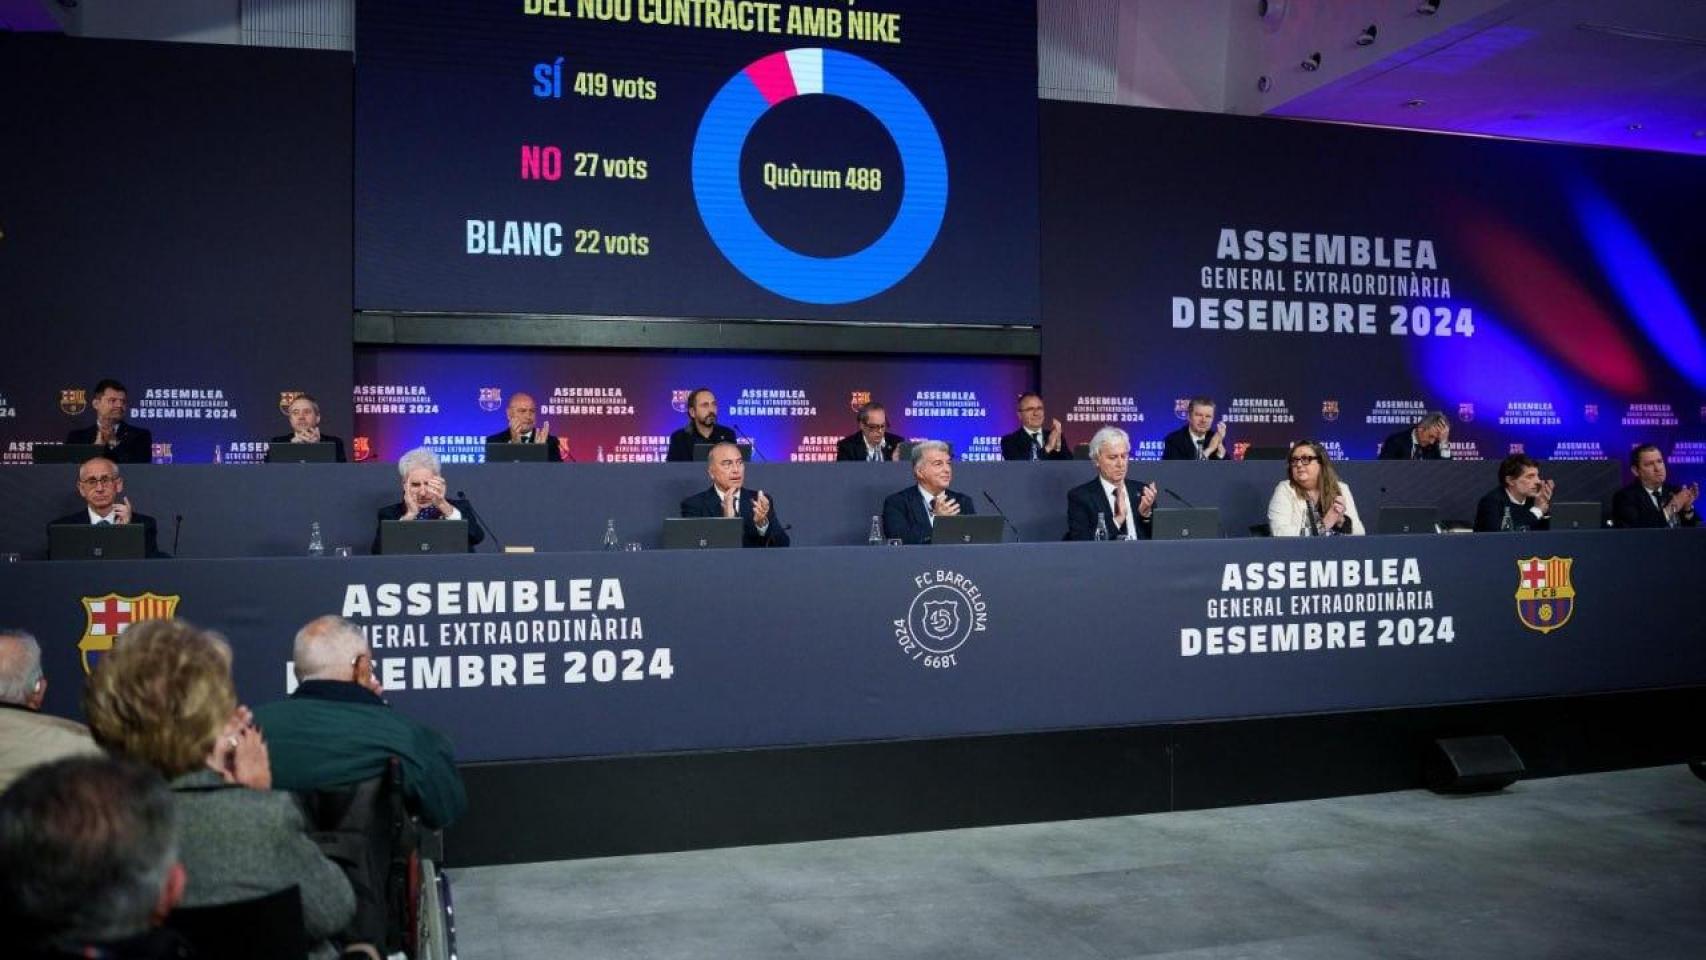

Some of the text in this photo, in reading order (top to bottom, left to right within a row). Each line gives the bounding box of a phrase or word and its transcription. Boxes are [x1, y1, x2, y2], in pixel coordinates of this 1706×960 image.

[638, 0, 781, 34] CONTRACTE
[787, 5, 842, 38] AMB
[849, 11, 901, 43] NIKE
[533, 57, 656, 100] SÍ 419 vots
[521, 145, 648, 181] NO 27 vots
[764, 162, 881, 191] Quòrum 488
[466, 219, 649, 257] BLANC 22 vots
[1217, 228, 1437, 270] ASSEMBLEA
[1201, 266, 1451, 299] GENERAL EXTRAORDINÀRIA
[1172, 296, 1475, 338] DESEMBRE 2024
[145, 388, 224, 399] ASSEMBLEA
[353, 386, 426, 396] ASSEMBLEA
[554, 387, 622, 397] ASSEMBLEA
[742, 389, 806, 398] ASSEMBLEA
[130, 407, 238, 419] DESEMBRE 2024
[409, 404, 439, 414] 2024
[541, 405, 634, 415] DESEMBRE 2024
[730, 407, 817, 416] DESEMBRE 2024
[1221, 557, 1422, 591] ASSEMBLEA
[341, 577, 625, 617] ASSEMBLEA
[914, 570, 988, 632] FC BARCELONA
[1207, 588, 1434, 619] GENERAL EXTRAORDINÀRIA
[440, 613, 643, 645] EXTRAORDINÀRIA
[893, 618, 916, 655] 2024
[1180, 616, 1456, 657] DESEMBRE 2024
[564, 647, 674, 684] 2024
